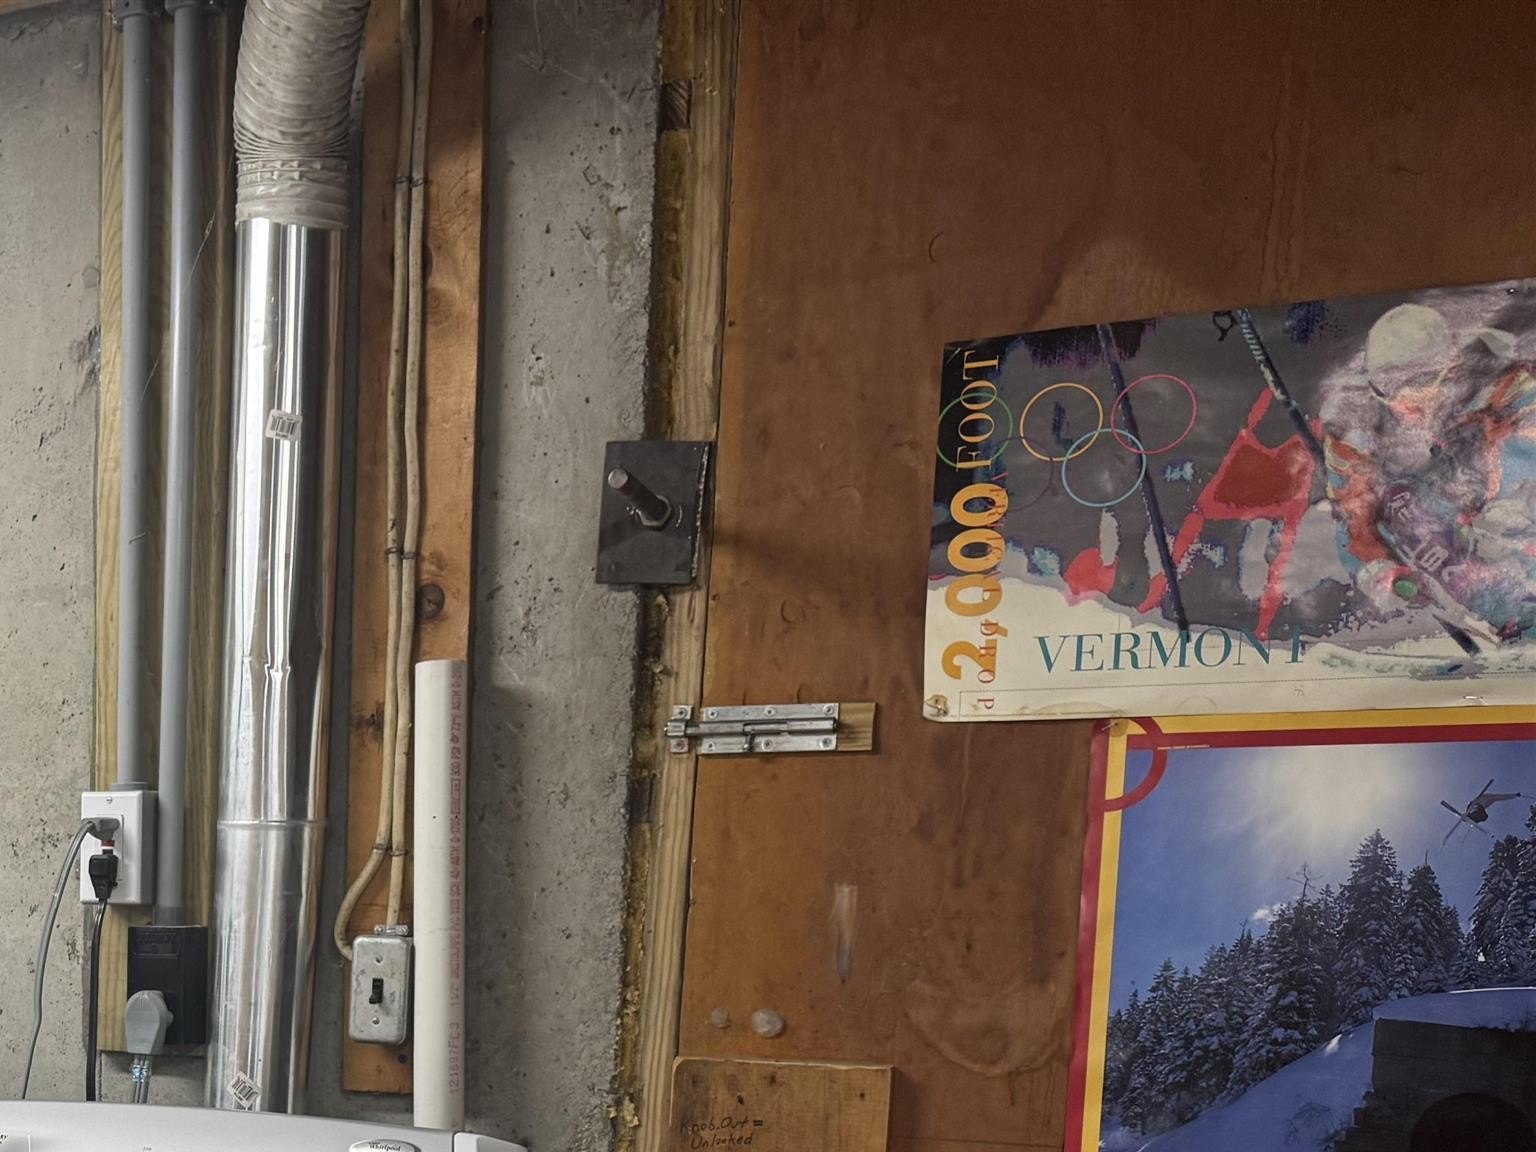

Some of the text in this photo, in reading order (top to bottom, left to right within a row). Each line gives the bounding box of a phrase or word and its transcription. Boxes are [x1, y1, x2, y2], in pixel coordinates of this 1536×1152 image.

[956, 350, 999, 472] FOOT
[1033, 625, 1305, 674] VERMONT
[368, 1141, 401, 1152] Whirlpool
[690, 1132, 753, 1150] Unlocked
